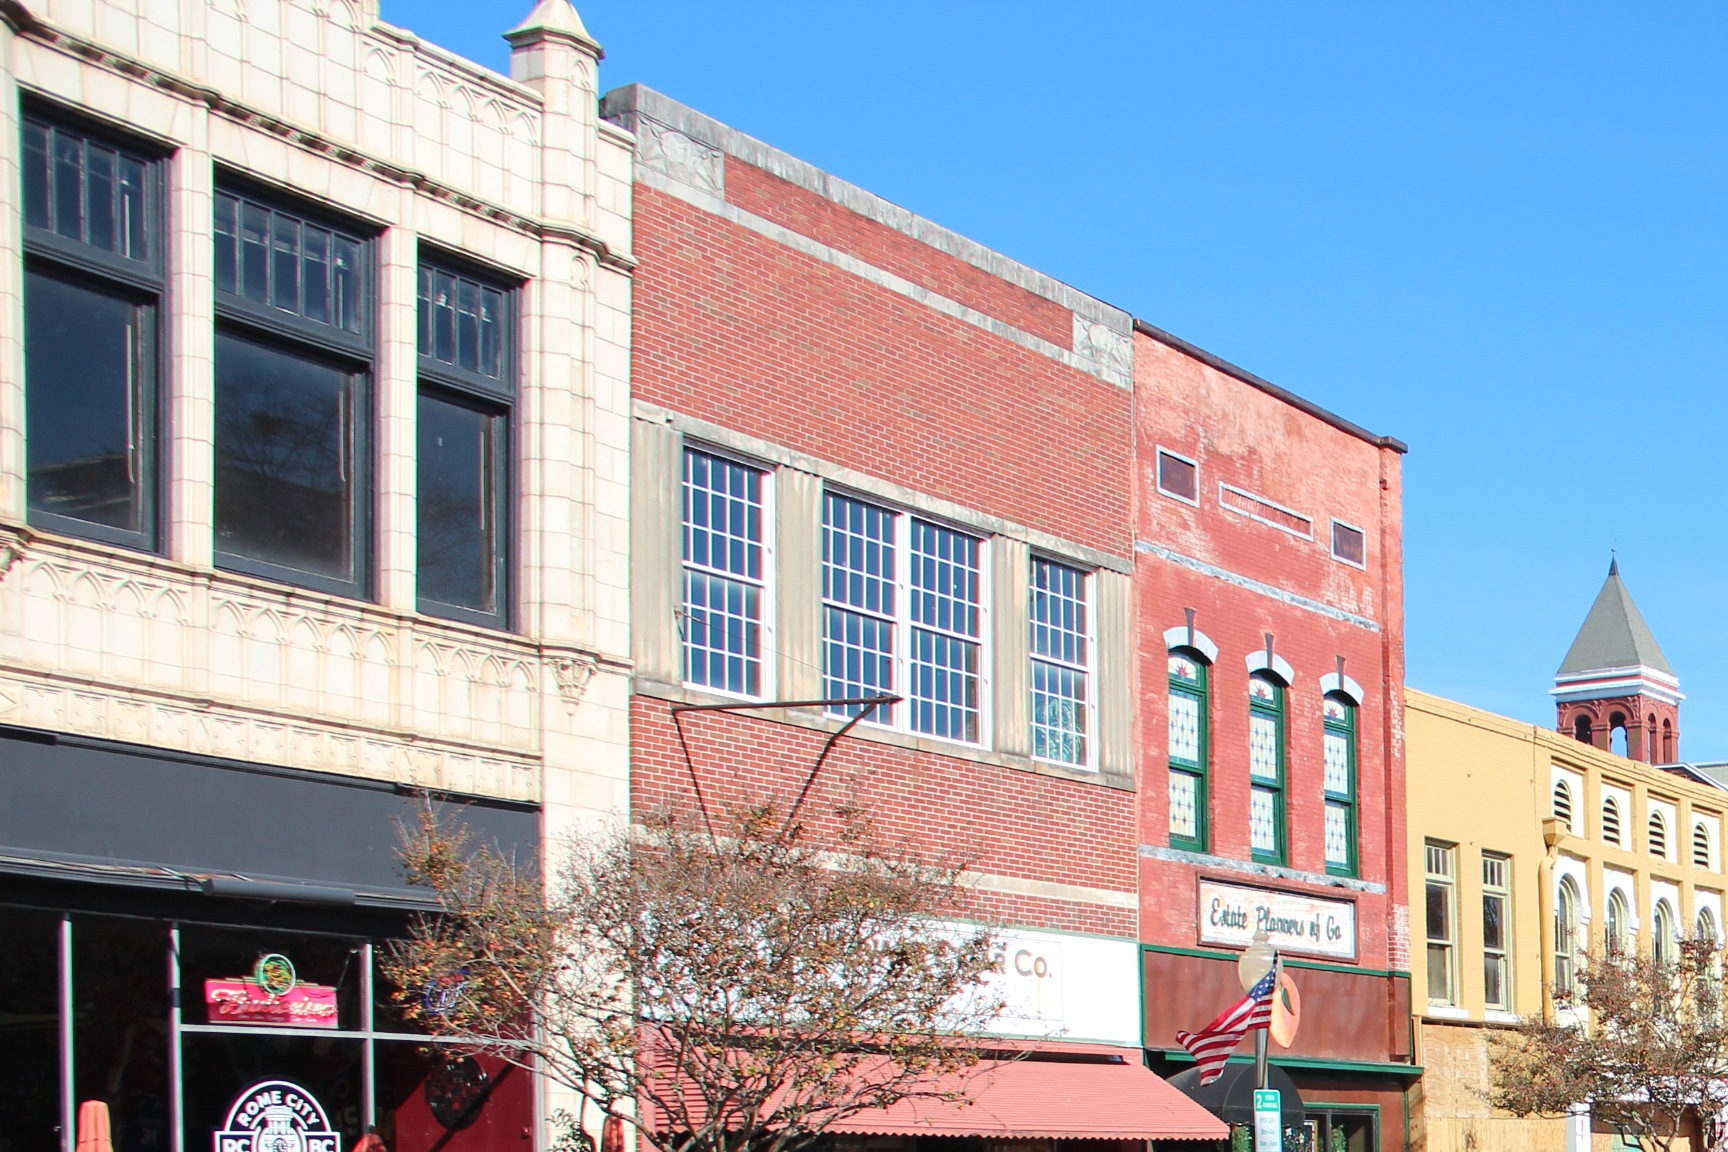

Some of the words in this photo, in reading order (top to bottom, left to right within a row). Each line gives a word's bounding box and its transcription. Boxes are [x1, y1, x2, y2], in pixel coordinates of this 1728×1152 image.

[1210, 897, 1248, 930] Estate
[1255, 905, 1305, 937] Planners
[1309, 913, 1320, 943] of
[1326, 915, 1342, 941] Ga
[1014, 948, 1053, 979] Co.
[236, 1090, 283, 1127] ROME
[285, 1093, 320, 1126] CITY
[1256, 1093, 1263, 1109] 2
